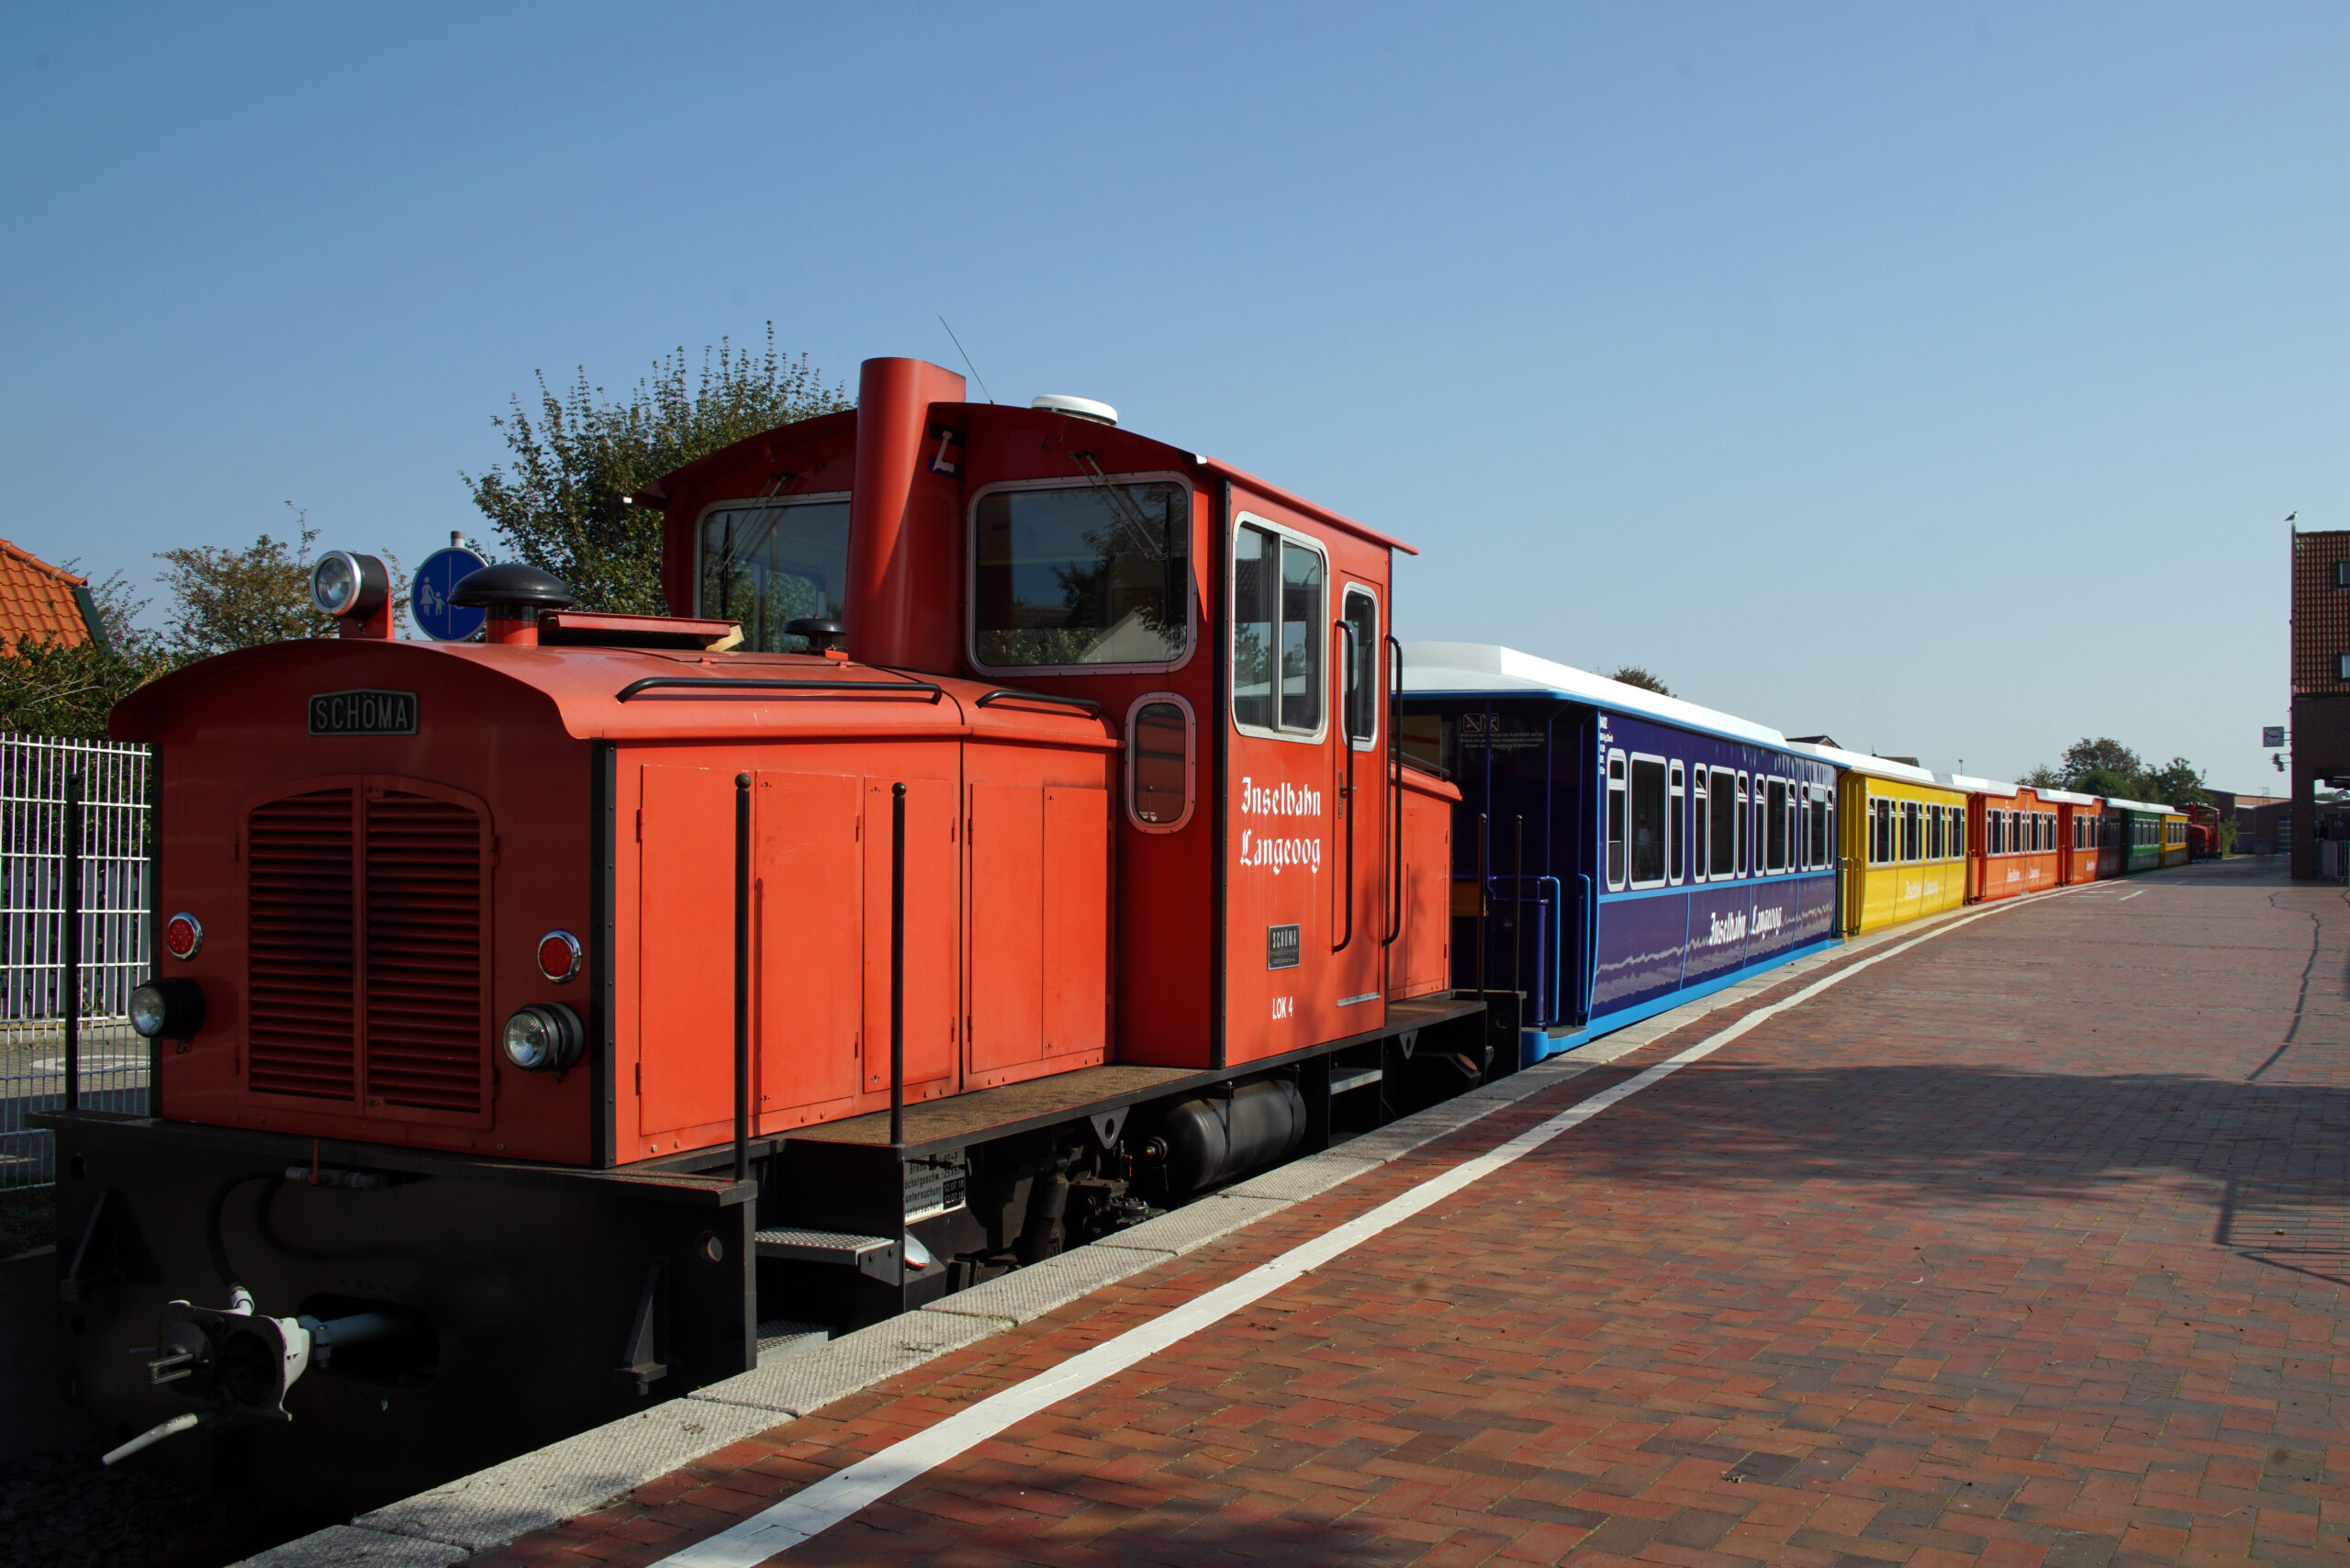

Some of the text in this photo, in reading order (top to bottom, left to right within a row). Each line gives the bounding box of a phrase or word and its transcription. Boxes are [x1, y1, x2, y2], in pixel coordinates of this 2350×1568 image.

[316, 694, 408, 729] SCHÖMA
[1241, 777, 1321, 816] Inselbahn
[1240, 828, 1320, 875] Langeoog
[1272, 929, 1297, 948] SCHÖMA
[1709, 904, 1783, 946] Inselbahn Langeoog
[1272, 995, 1293, 1019] LOK 4
